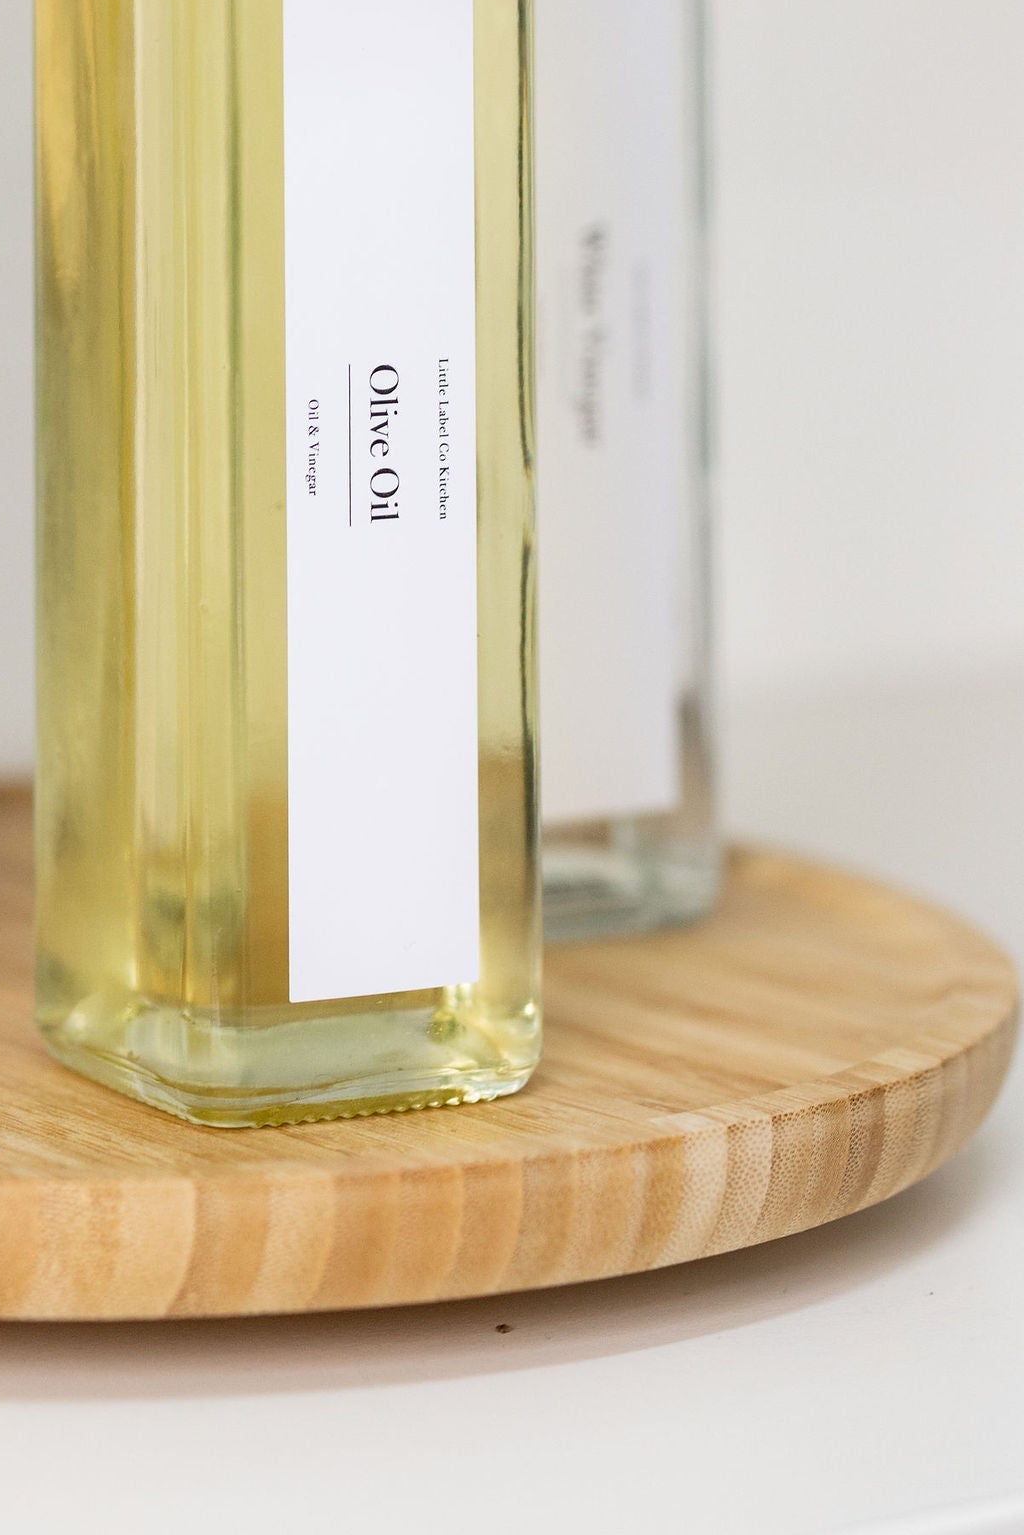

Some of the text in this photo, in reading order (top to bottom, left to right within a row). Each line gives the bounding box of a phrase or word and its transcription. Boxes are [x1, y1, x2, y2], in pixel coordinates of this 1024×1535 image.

[305, 399, 320, 496] Oil & Vinegar
[369, 364, 400, 524] Olive Oil
[438, 358, 450, 520] Little Label Co Kitchen
